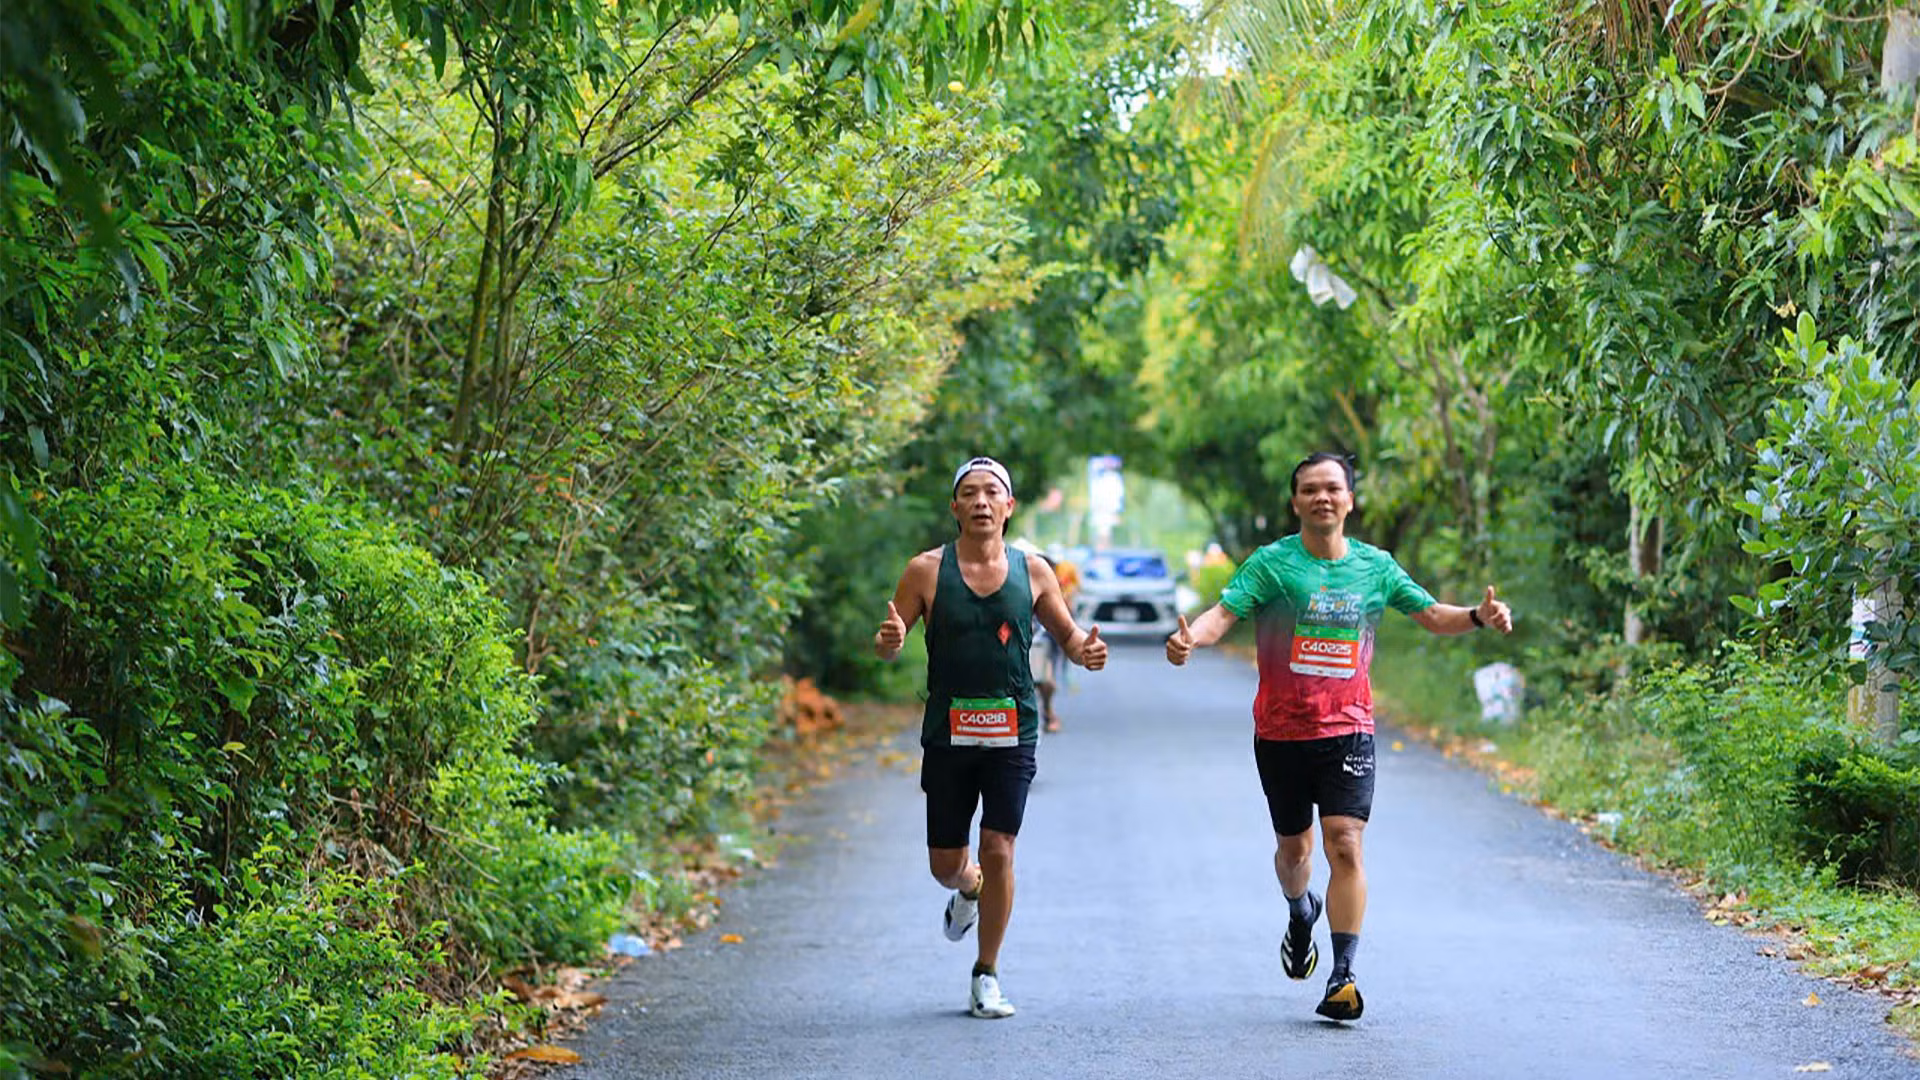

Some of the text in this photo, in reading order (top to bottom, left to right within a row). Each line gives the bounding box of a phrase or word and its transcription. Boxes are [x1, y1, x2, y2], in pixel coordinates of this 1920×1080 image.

[1307, 600, 1360, 613] MUSIC
[1301, 640, 1353, 655] C40225
[959, 712, 1007, 725] C40218
